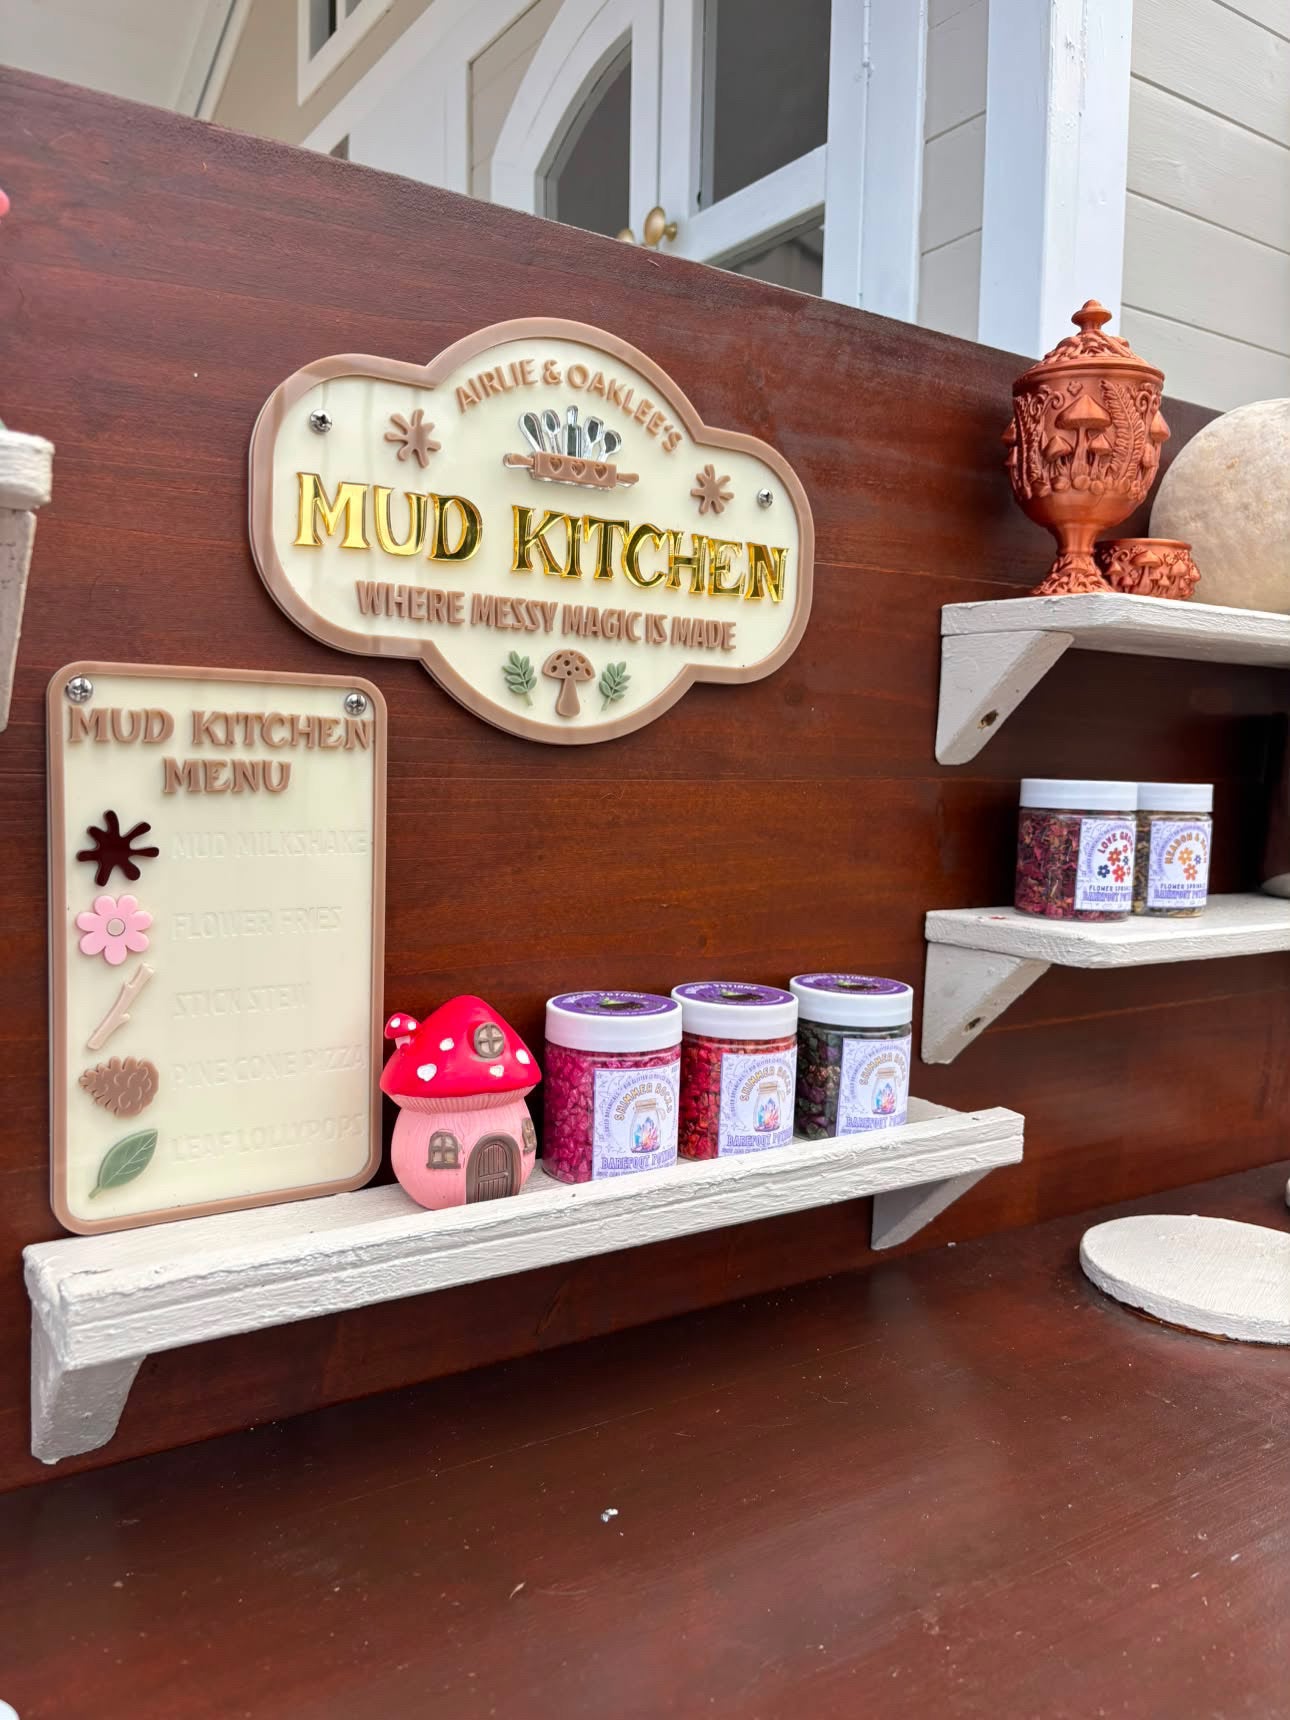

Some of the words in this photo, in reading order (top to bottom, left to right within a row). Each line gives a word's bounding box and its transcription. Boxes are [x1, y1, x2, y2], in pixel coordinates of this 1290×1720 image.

[455, 358, 538, 415] AIRLIE
[542, 359, 563, 385] &
[567, 363, 683, 452] OAKLEE'S
[293, 471, 483, 562] MUD
[511, 503, 790, 603] KITCHEN
[355, 579, 466, 625] WHERE
[470, 592, 559, 633] MESSY
[562, 603, 643, 642] MAGIC
[644, 612, 668, 644] IS
[671, 616, 737, 651] MADE
[68, 704, 175, 744] MUD
[191, 709, 375, 751] KITCHEN
[162, 755, 292, 794] MENU
[170, 831, 227, 860] MUD
[236, 830, 369, 858] MILKSHAKE
[1097, 832, 1118, 854] LOVE
[171, 909, 273, 941] FLOWER
[279, 906, 344, 935] FRIES
[172, 987, 241, 1019] STICK
[233, 1051, 297, 1083] CONE
[739, 1065, 776, 1102] SHIMMER
[614, 1082, 653, 1121] SHIMMER
[168, 1130, 234, 1165] LEAF
[600, 1154, 650, 1170] BAREFOOT
